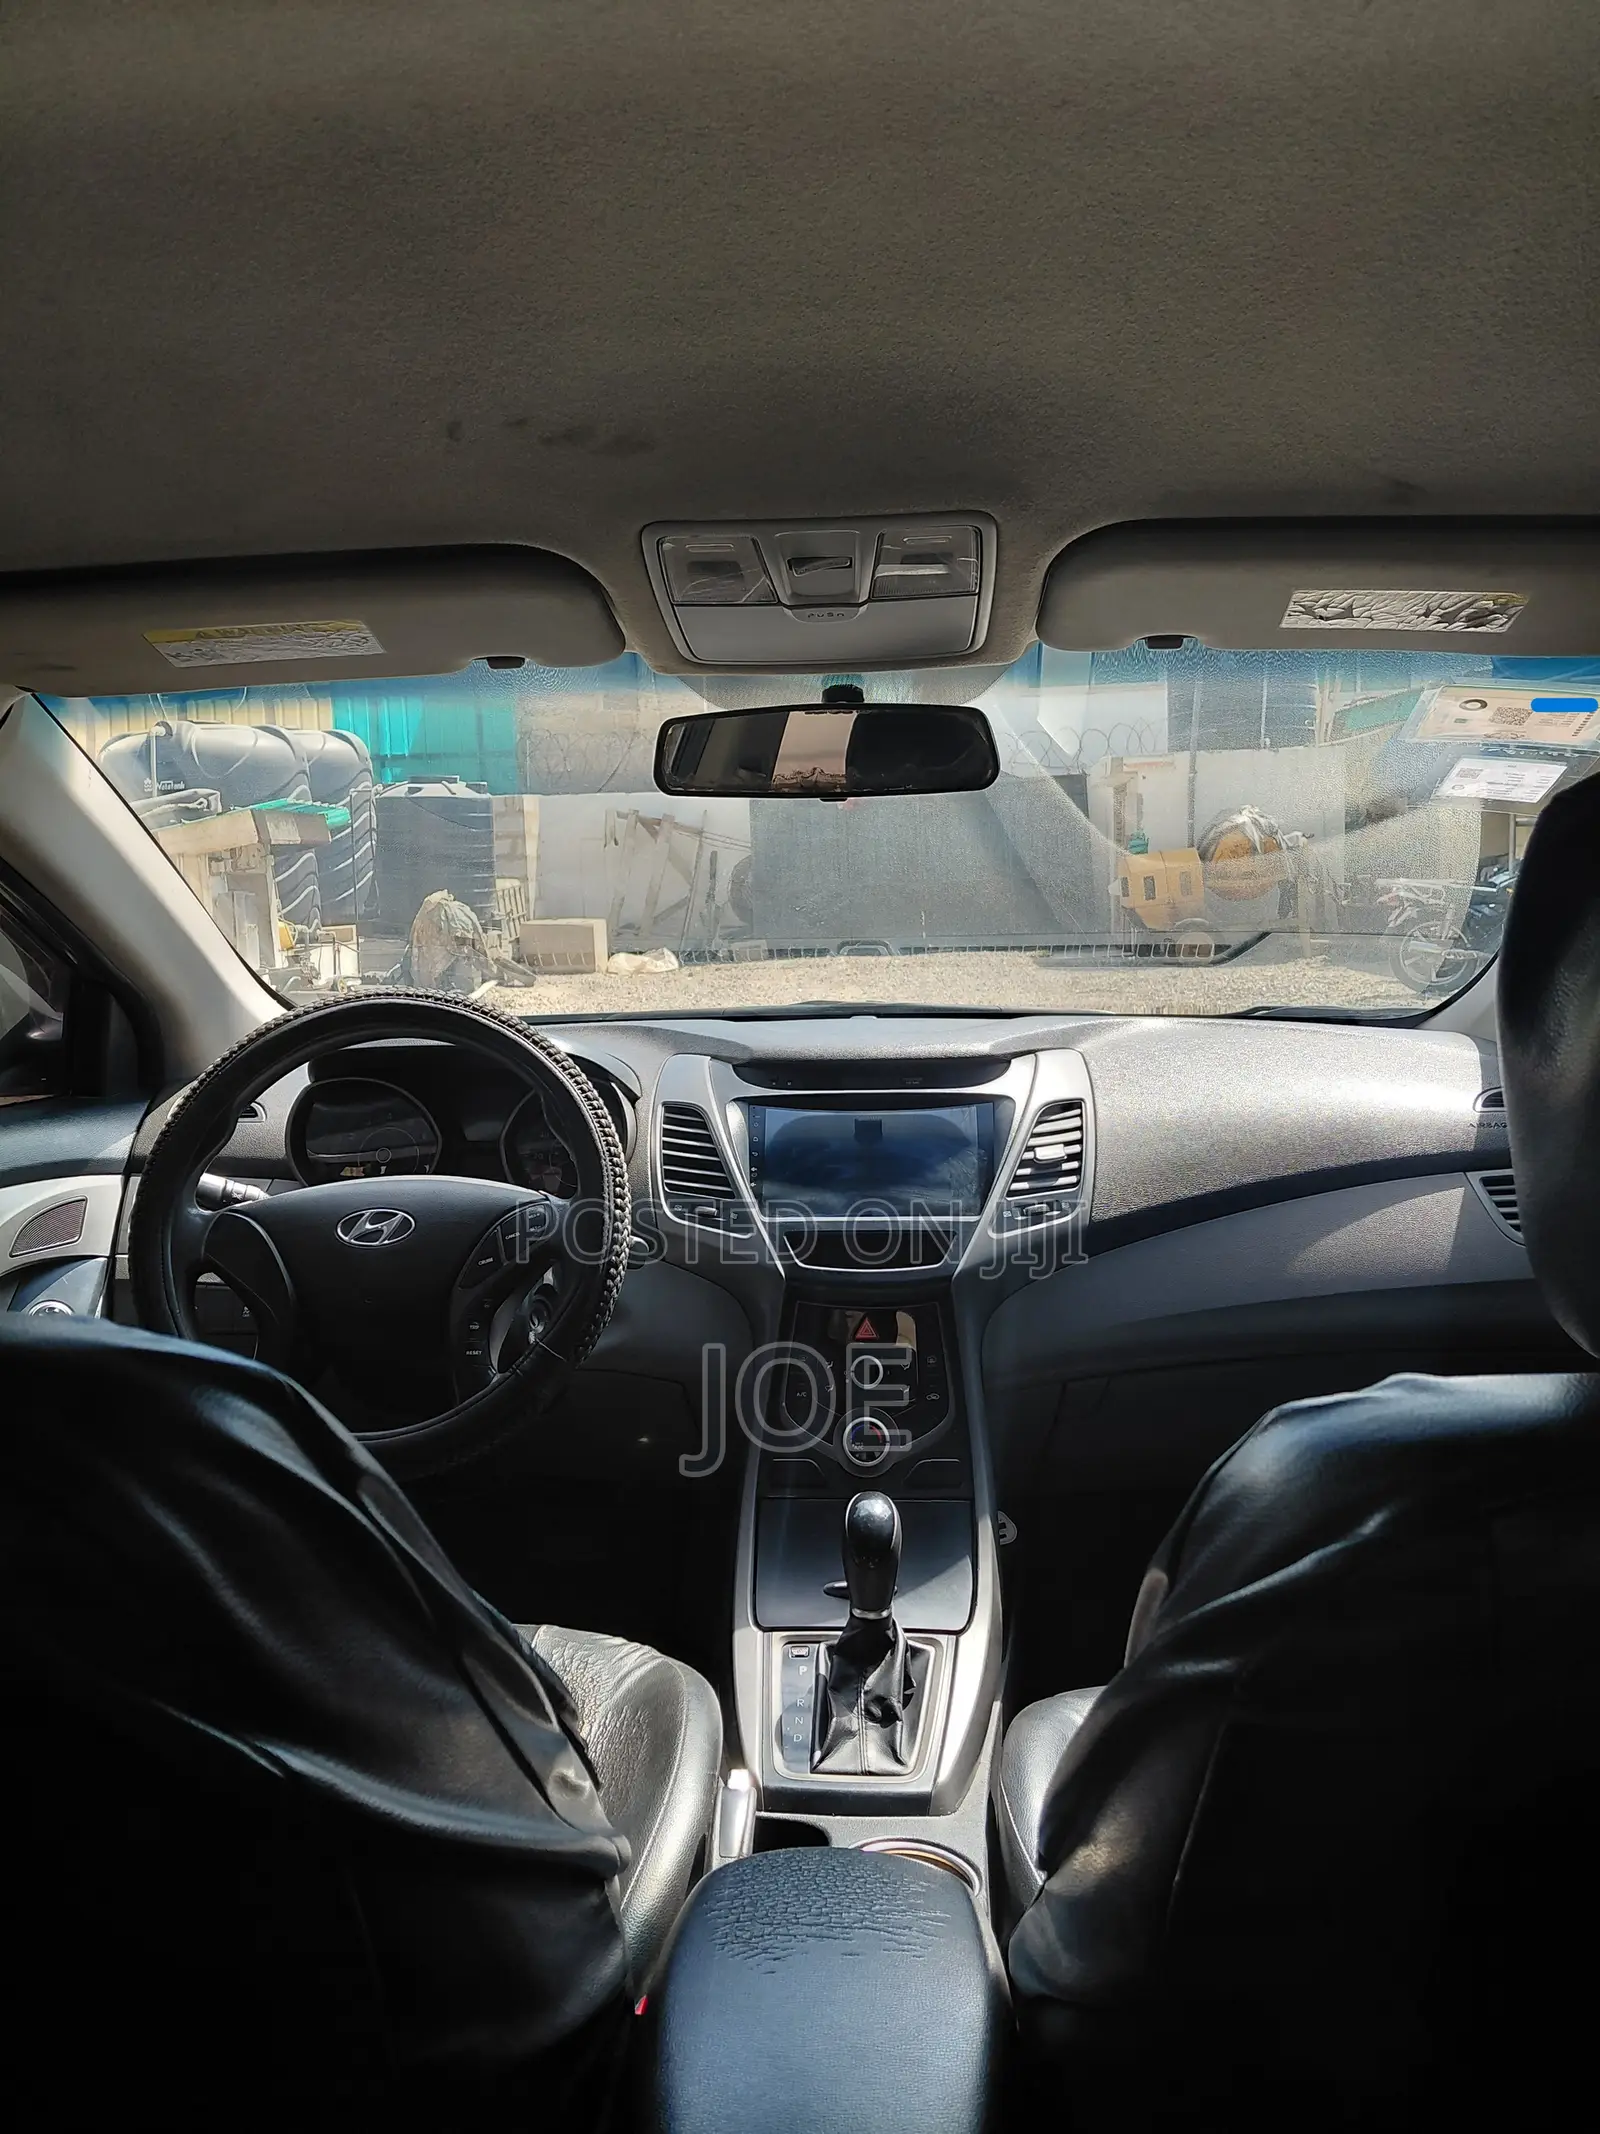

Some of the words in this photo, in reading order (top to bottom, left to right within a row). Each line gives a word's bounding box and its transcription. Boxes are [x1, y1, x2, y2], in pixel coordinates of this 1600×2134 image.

[799, 1665, 808, 1676] P
[796, 1698, 805, 1708] R
[795, 1716, 804, 1725] N
[793, 1734, 803, 1742] D
